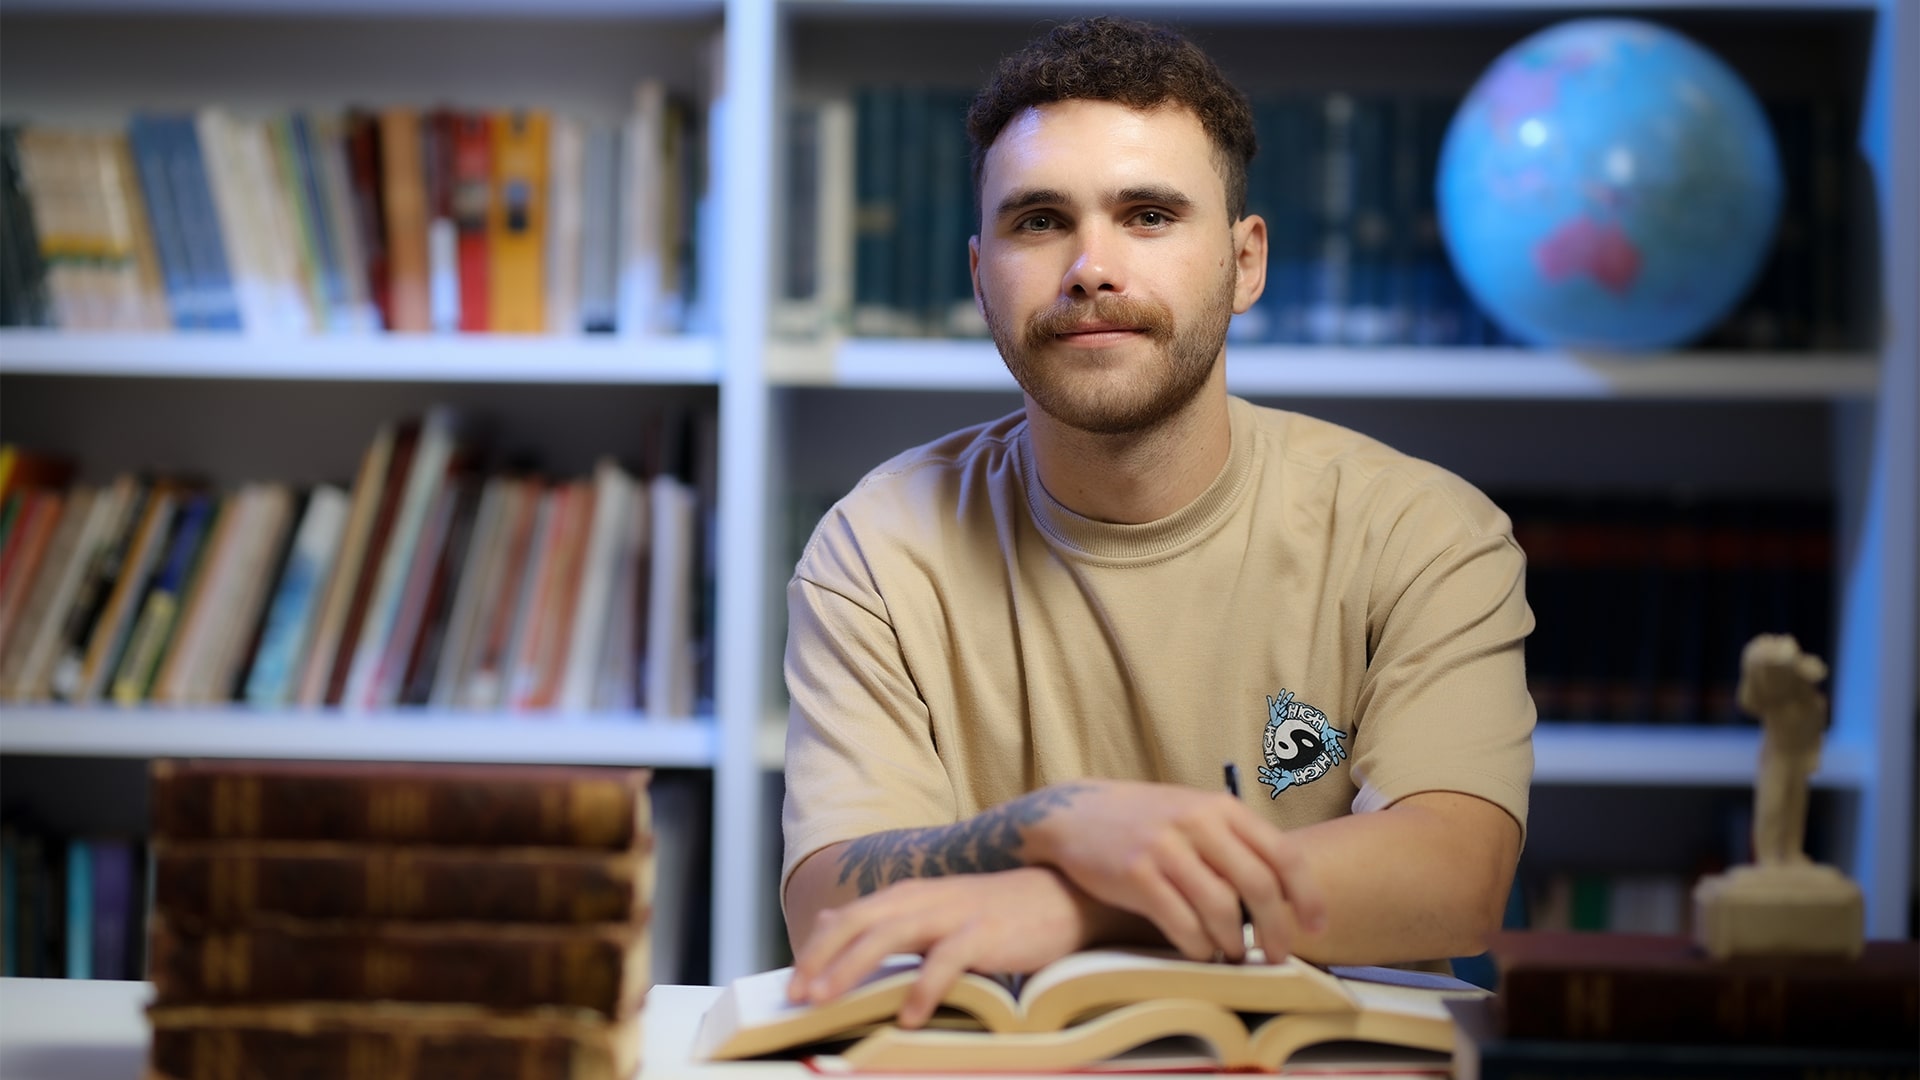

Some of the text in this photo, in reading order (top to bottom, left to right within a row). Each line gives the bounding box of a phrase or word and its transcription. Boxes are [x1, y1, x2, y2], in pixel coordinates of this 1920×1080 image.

[1287, 703, 1325, 731] HIGH
[1264, 725, 1280, 766] HIGH
[1293, 752, 1332, 784] HIGH
